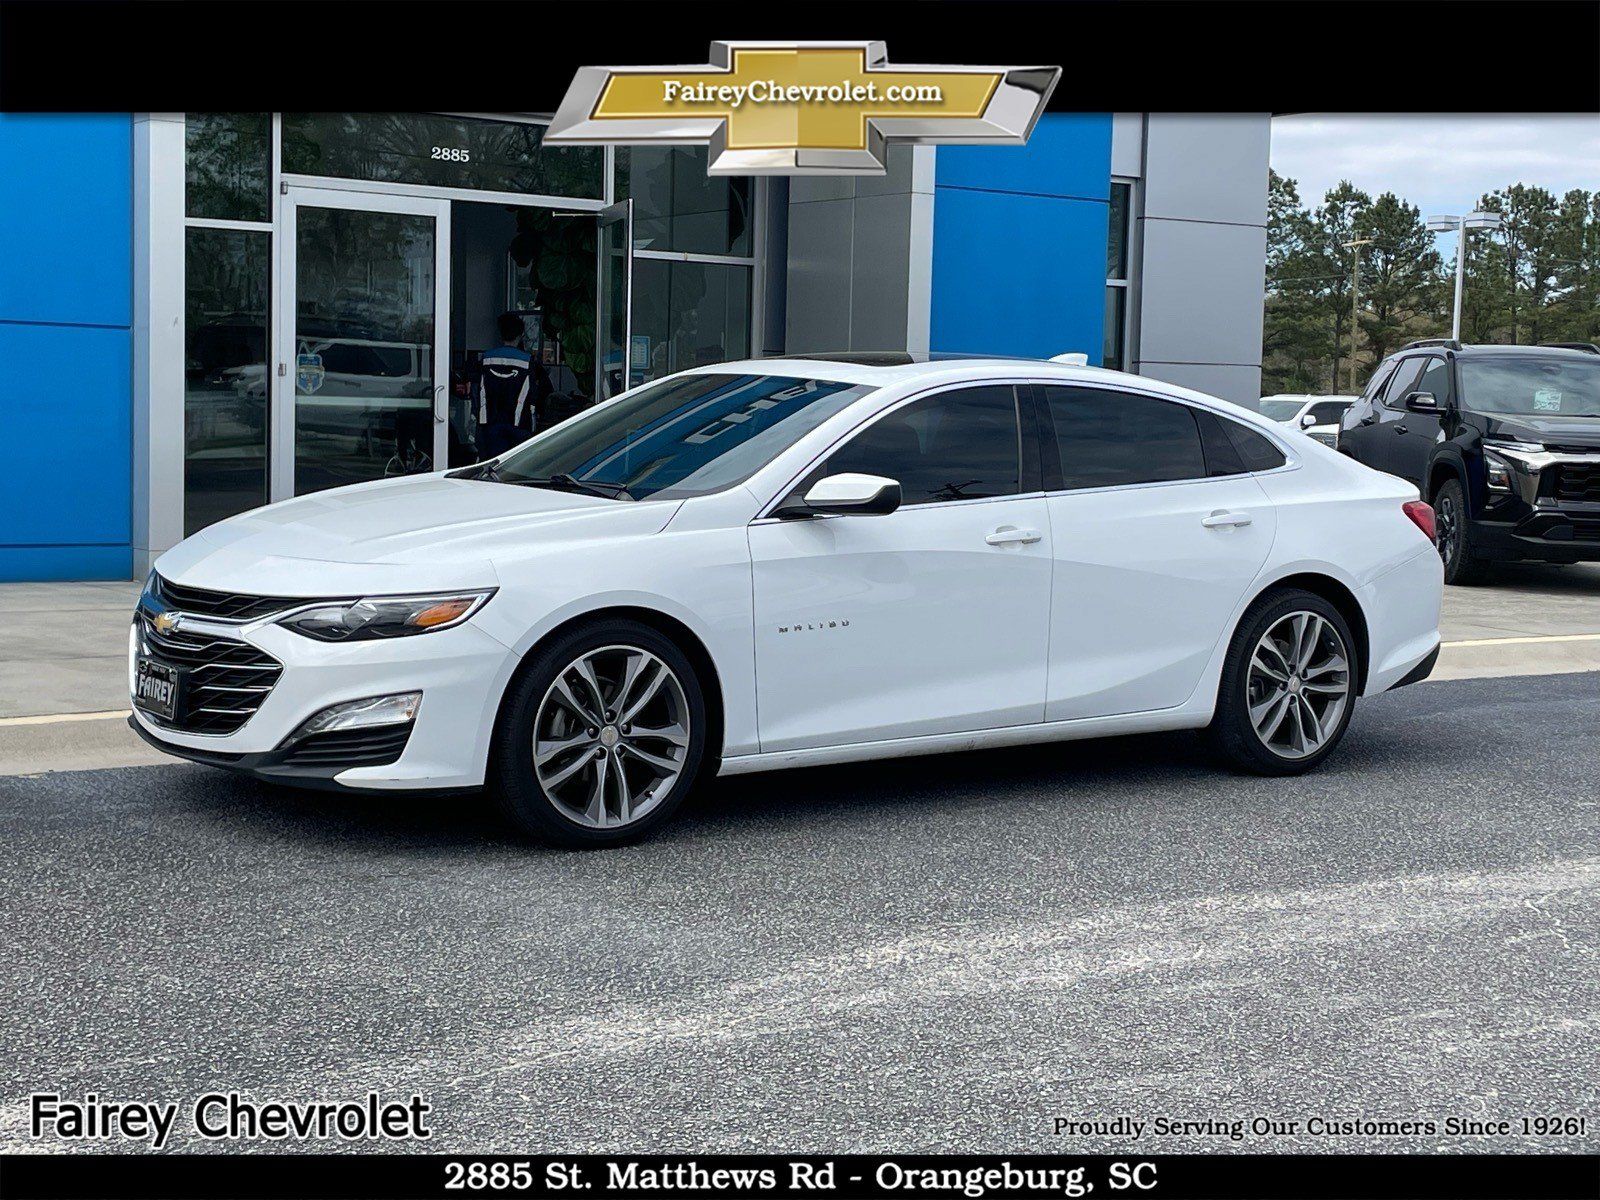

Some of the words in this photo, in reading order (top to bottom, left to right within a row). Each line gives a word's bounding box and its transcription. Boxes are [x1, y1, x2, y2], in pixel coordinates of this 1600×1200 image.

[431, 146, 470, 163] 2885
[778, 619, 850, 634] MALIBU
[138, 673, 175, 706] FAIREY
